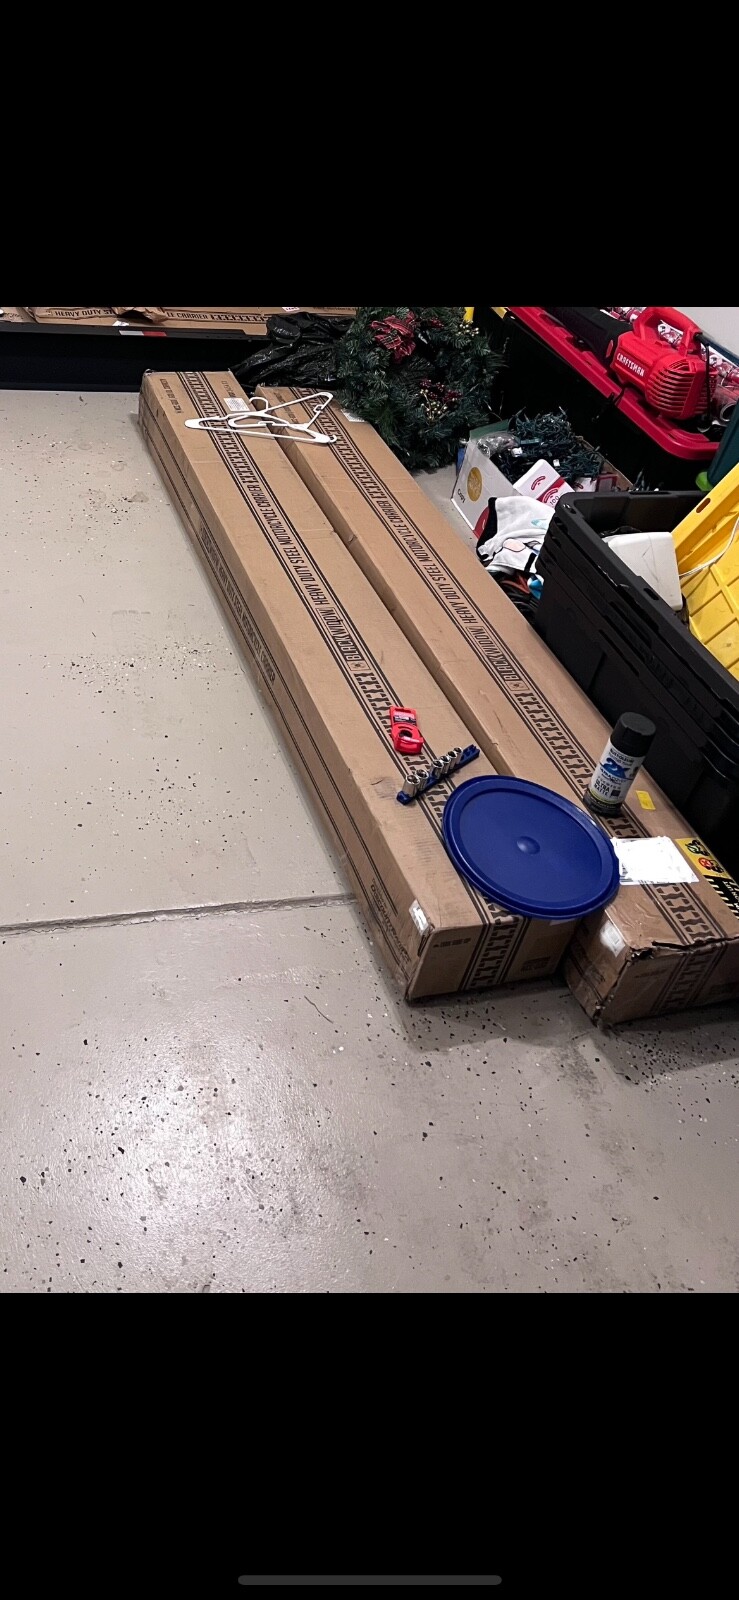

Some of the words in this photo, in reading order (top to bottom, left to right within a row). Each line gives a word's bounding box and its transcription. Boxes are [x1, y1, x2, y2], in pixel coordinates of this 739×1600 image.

[176, 312, 209, 320] CARRIER
[616, 352, 646, 377] CRAFTSMAN
[246, 484, 271, 508] CARRIER
[376, 500, 403, 526] CARRIER
[260, 508, 294, 546] MOTORCYCLE
[283, 546, 305, 564] STEEL
[395, 525, 431, 562] MOTORCYCLE
[293, 565, 316, 582] DUTY
[423, 562, 446, 583] STEEL
[304, 583, 330, 606] HEAVY
[437, 583, 460, 601] DUTY
[449, 600, 477, 624] HEAVY
[320, 609, 365, 662] BLACKWIDOW
[470, 627, 519, 682] BLACKWIDOW
[595, 780, 610, 791] ULTRA
